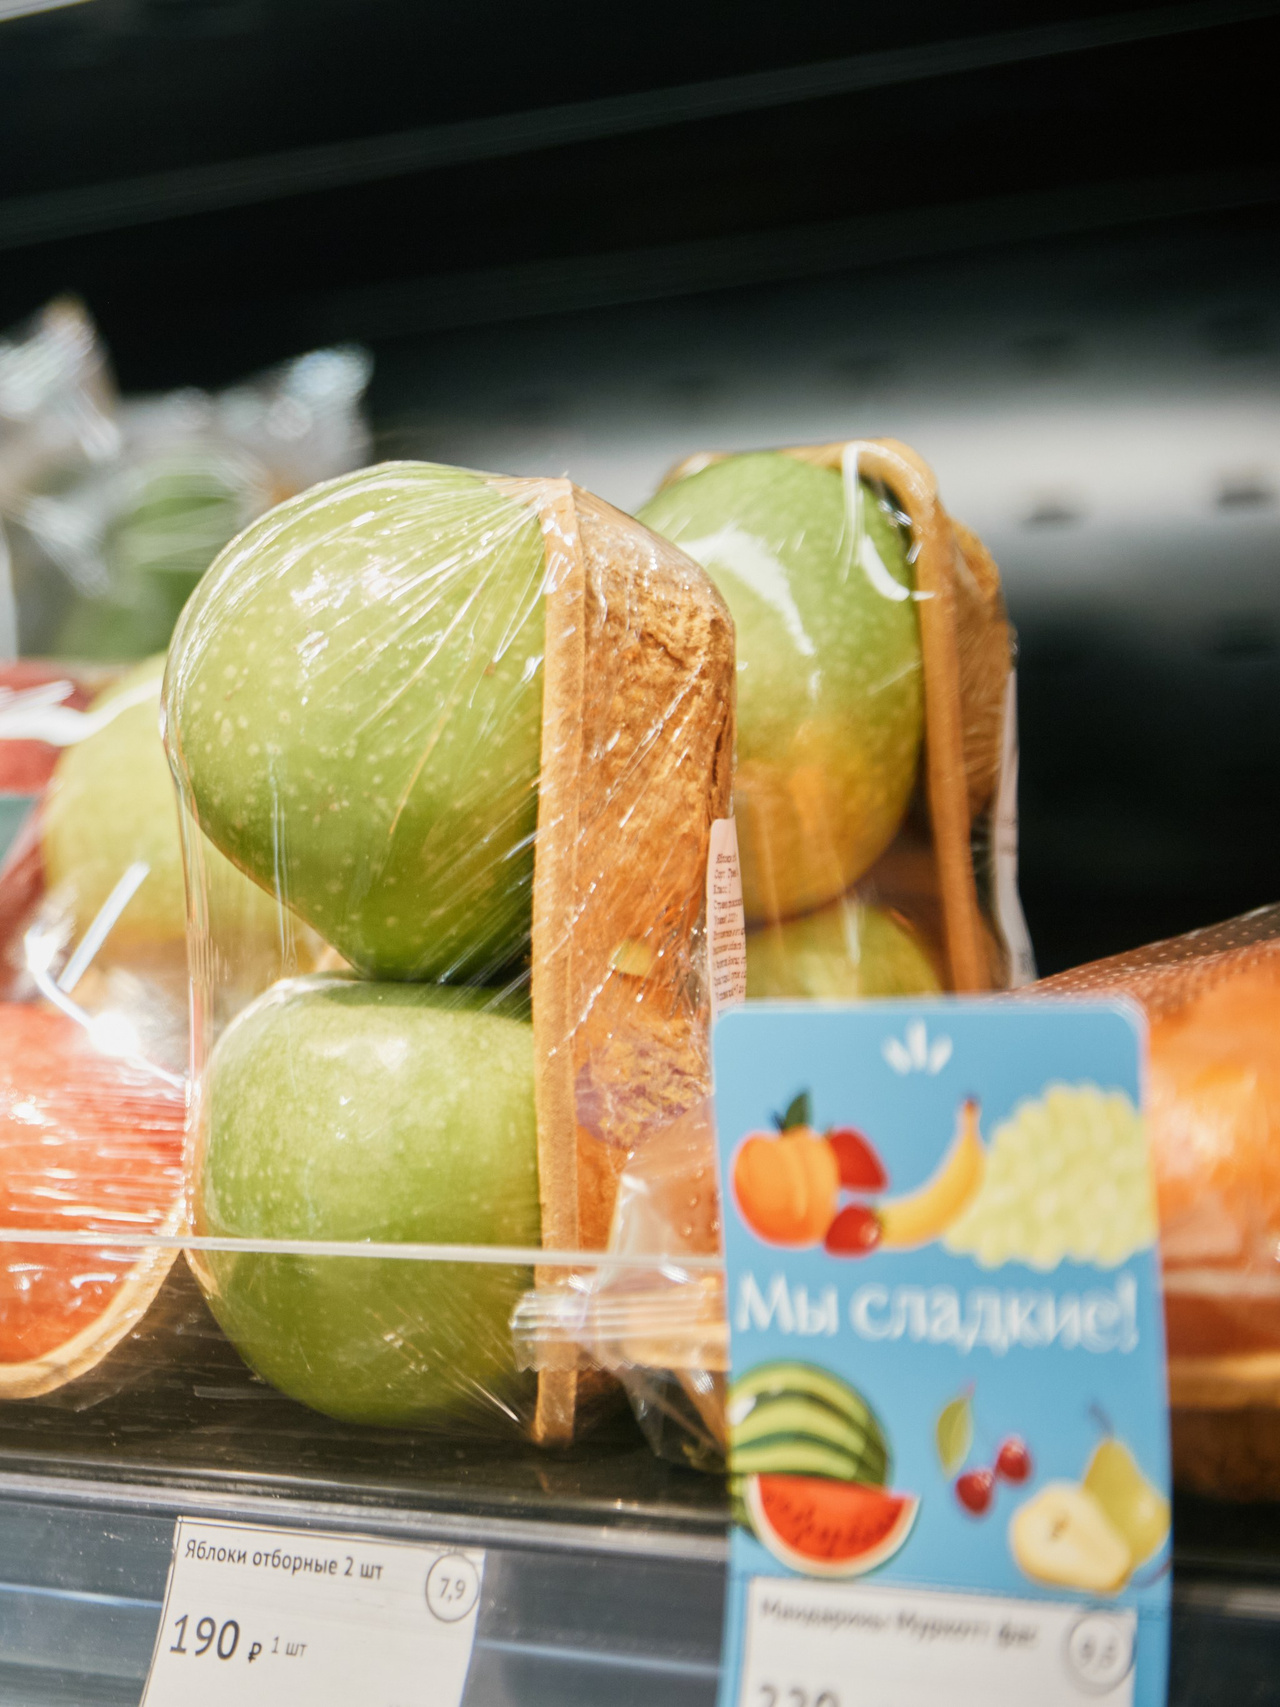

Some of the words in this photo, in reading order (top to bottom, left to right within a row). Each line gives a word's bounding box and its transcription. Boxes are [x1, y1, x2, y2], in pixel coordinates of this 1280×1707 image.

[734, 1271, 840, 1337] Мы
[849, 1270, 1140, 1357] сладкие!
[185, 1539, 247, 1564] Яблоки
[252, 1549, 338, 1577] отборные
[343, 1556, 354, 1577] 2
[360, 1563, 384, 1580] шт
[438, 1577, 467, 1603] 7,9
[170, 1613, 241, 1661] 190
[270, 1636, 280, 1656] 1
[285, 1640, 308, 1657] шт
